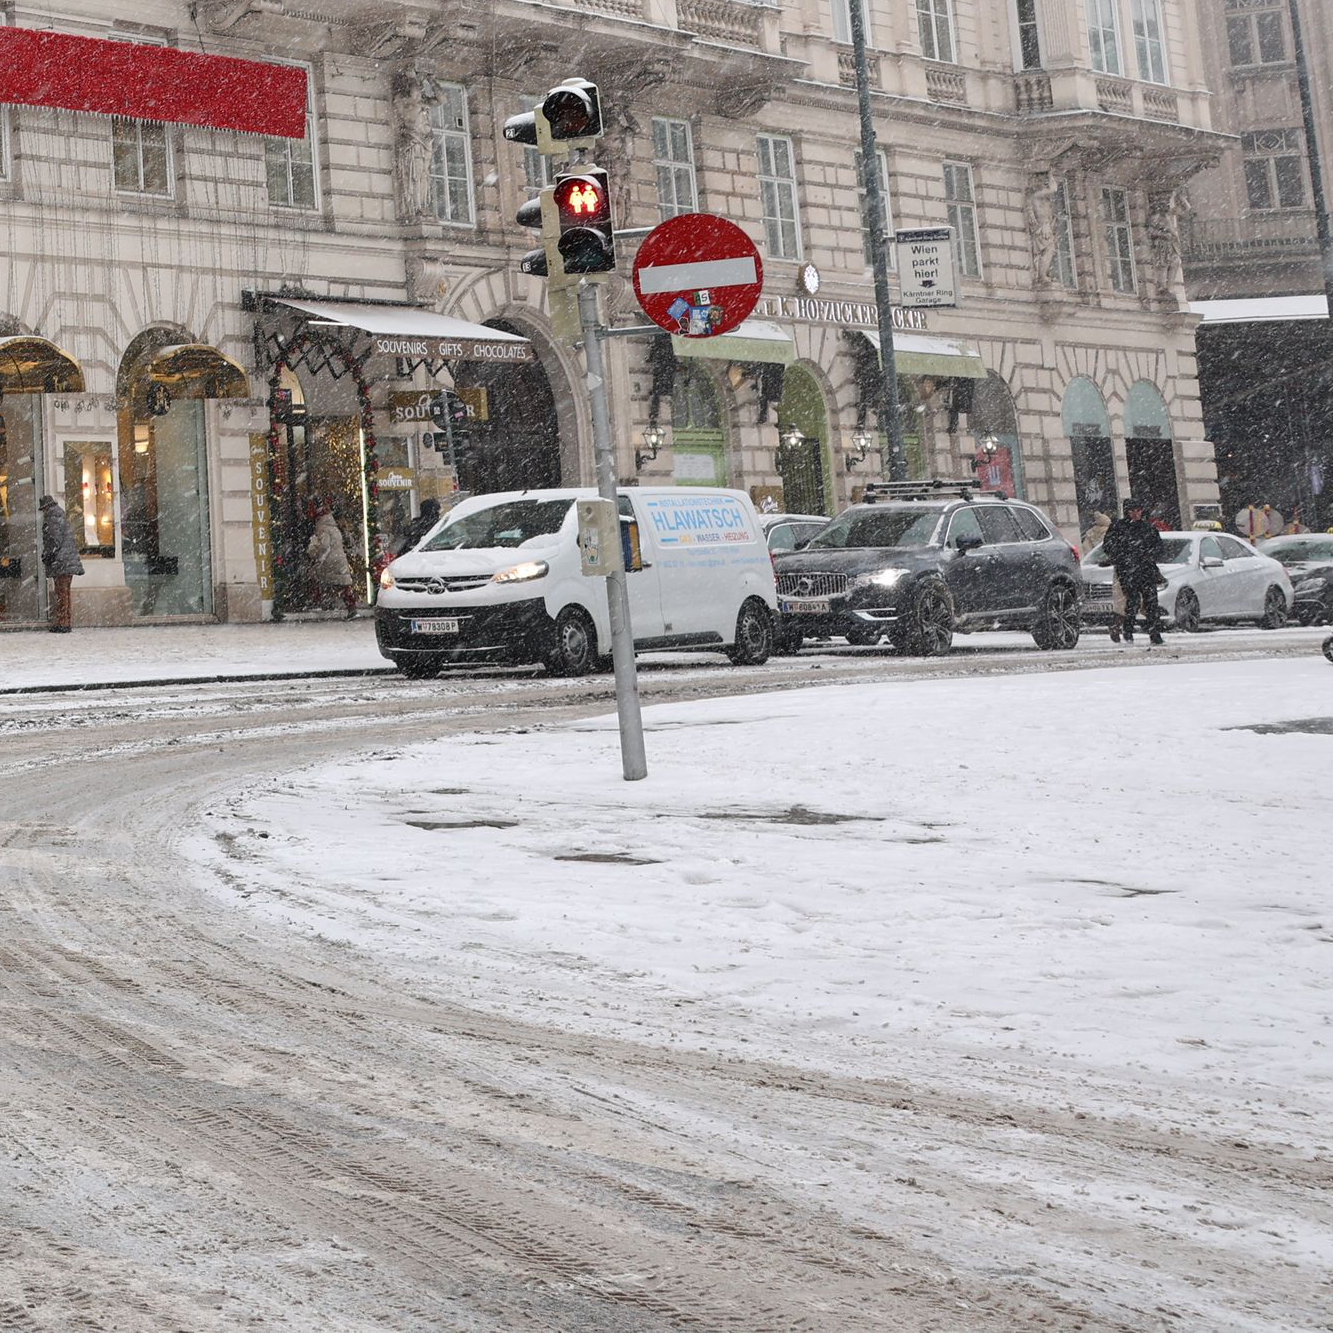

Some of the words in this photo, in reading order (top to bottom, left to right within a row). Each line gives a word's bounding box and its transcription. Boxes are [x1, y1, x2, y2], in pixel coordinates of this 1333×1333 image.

[911, 246, 938, 254] Wien
[912, 257, 939, 268] parkt
[914, 269, 939, 279] hier!
[936, 289, 953, 298] Ring
[796, 298, 929, 330] HOFZUCKERCKER
[377, 339, 428, 355] SOUVENIRS
[439, 343, 463, 356] GIFTS
[474, 344, 526, 359] CHOCOLATES
[379, 478, 413, 487] SOUVENIR
[651, 507, 745, 531] HLAWATSCH
[696, 533, 721, 543] WASSER
[724, 532, 750, 542] HEIZUNG
